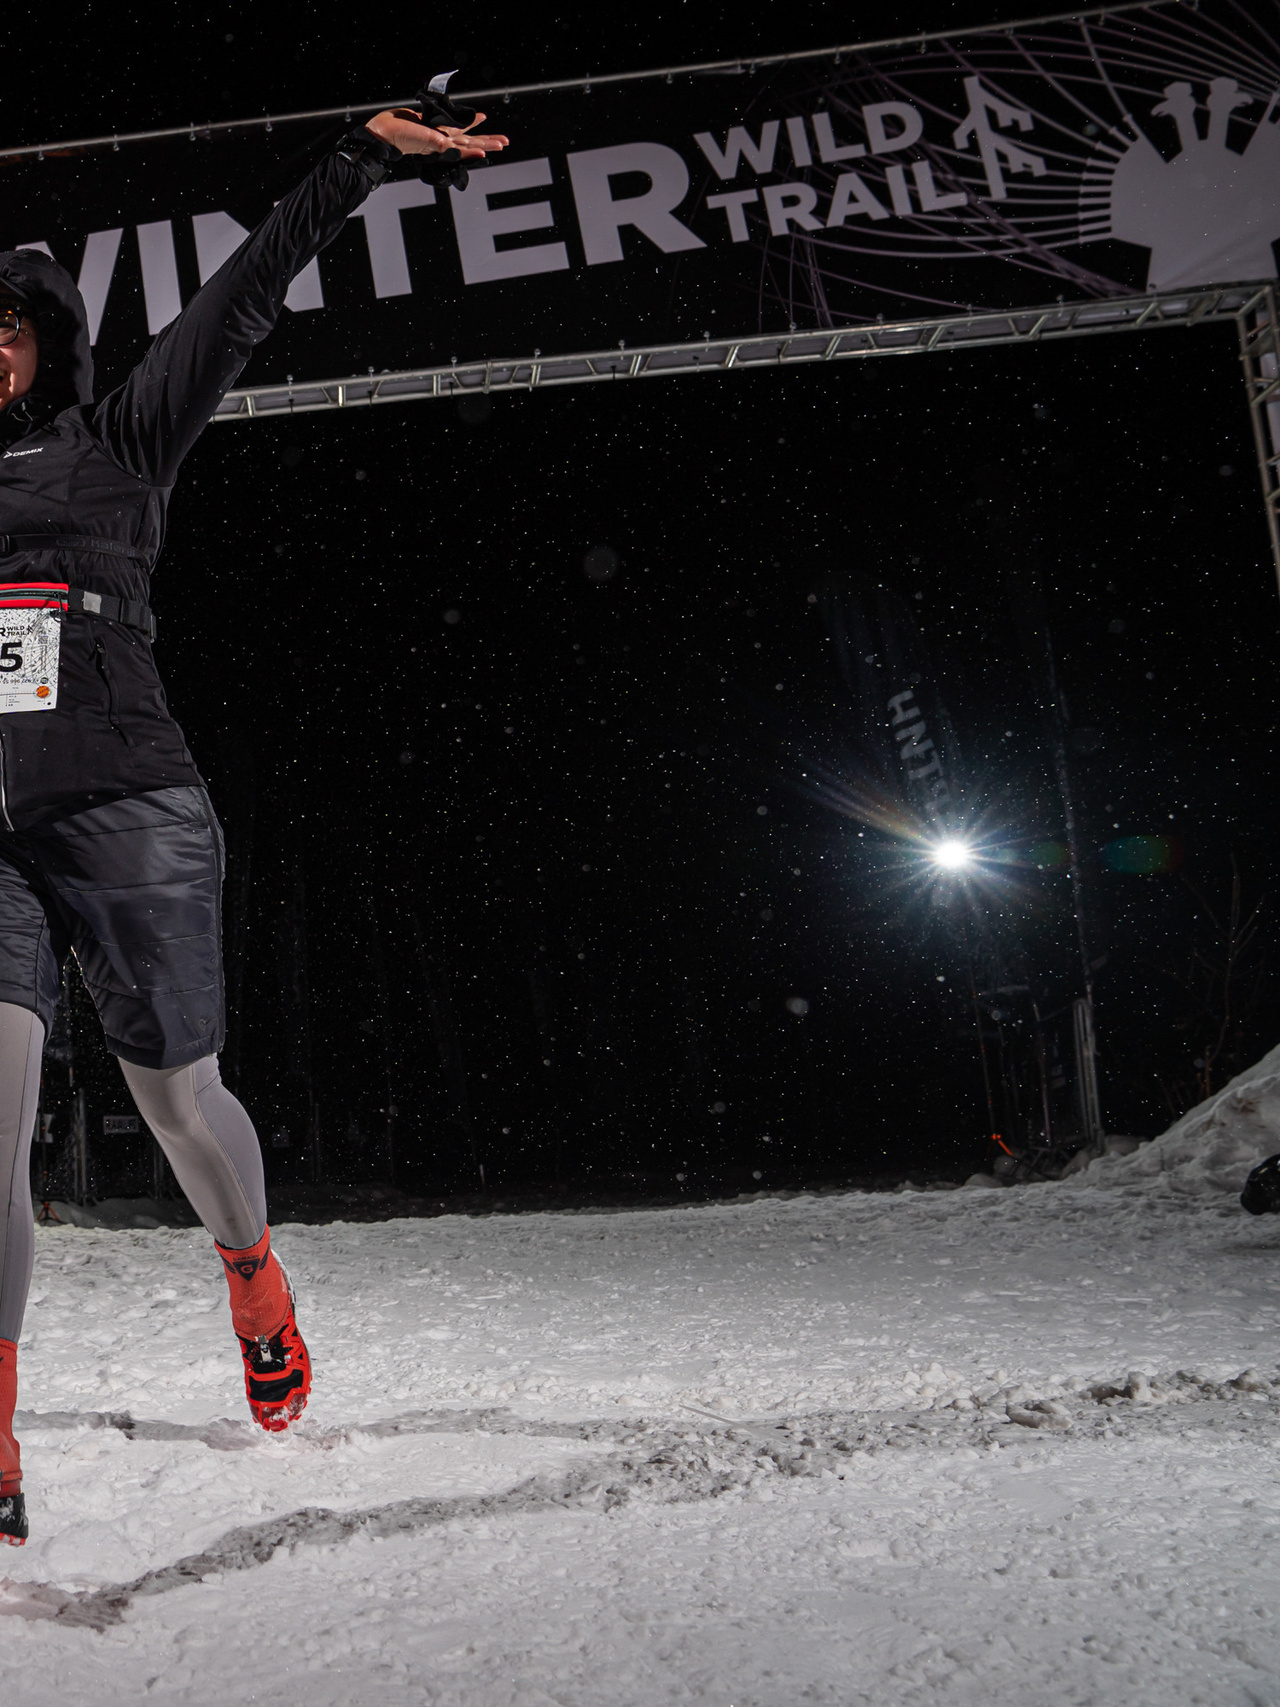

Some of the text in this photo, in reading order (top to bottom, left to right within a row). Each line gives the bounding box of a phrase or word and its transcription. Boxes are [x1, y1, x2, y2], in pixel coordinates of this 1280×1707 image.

[693, 99, 924, 186] WILD
[707, 160, 967, 243] TRAIL
[13, 447, 44, 457] DEMIX
